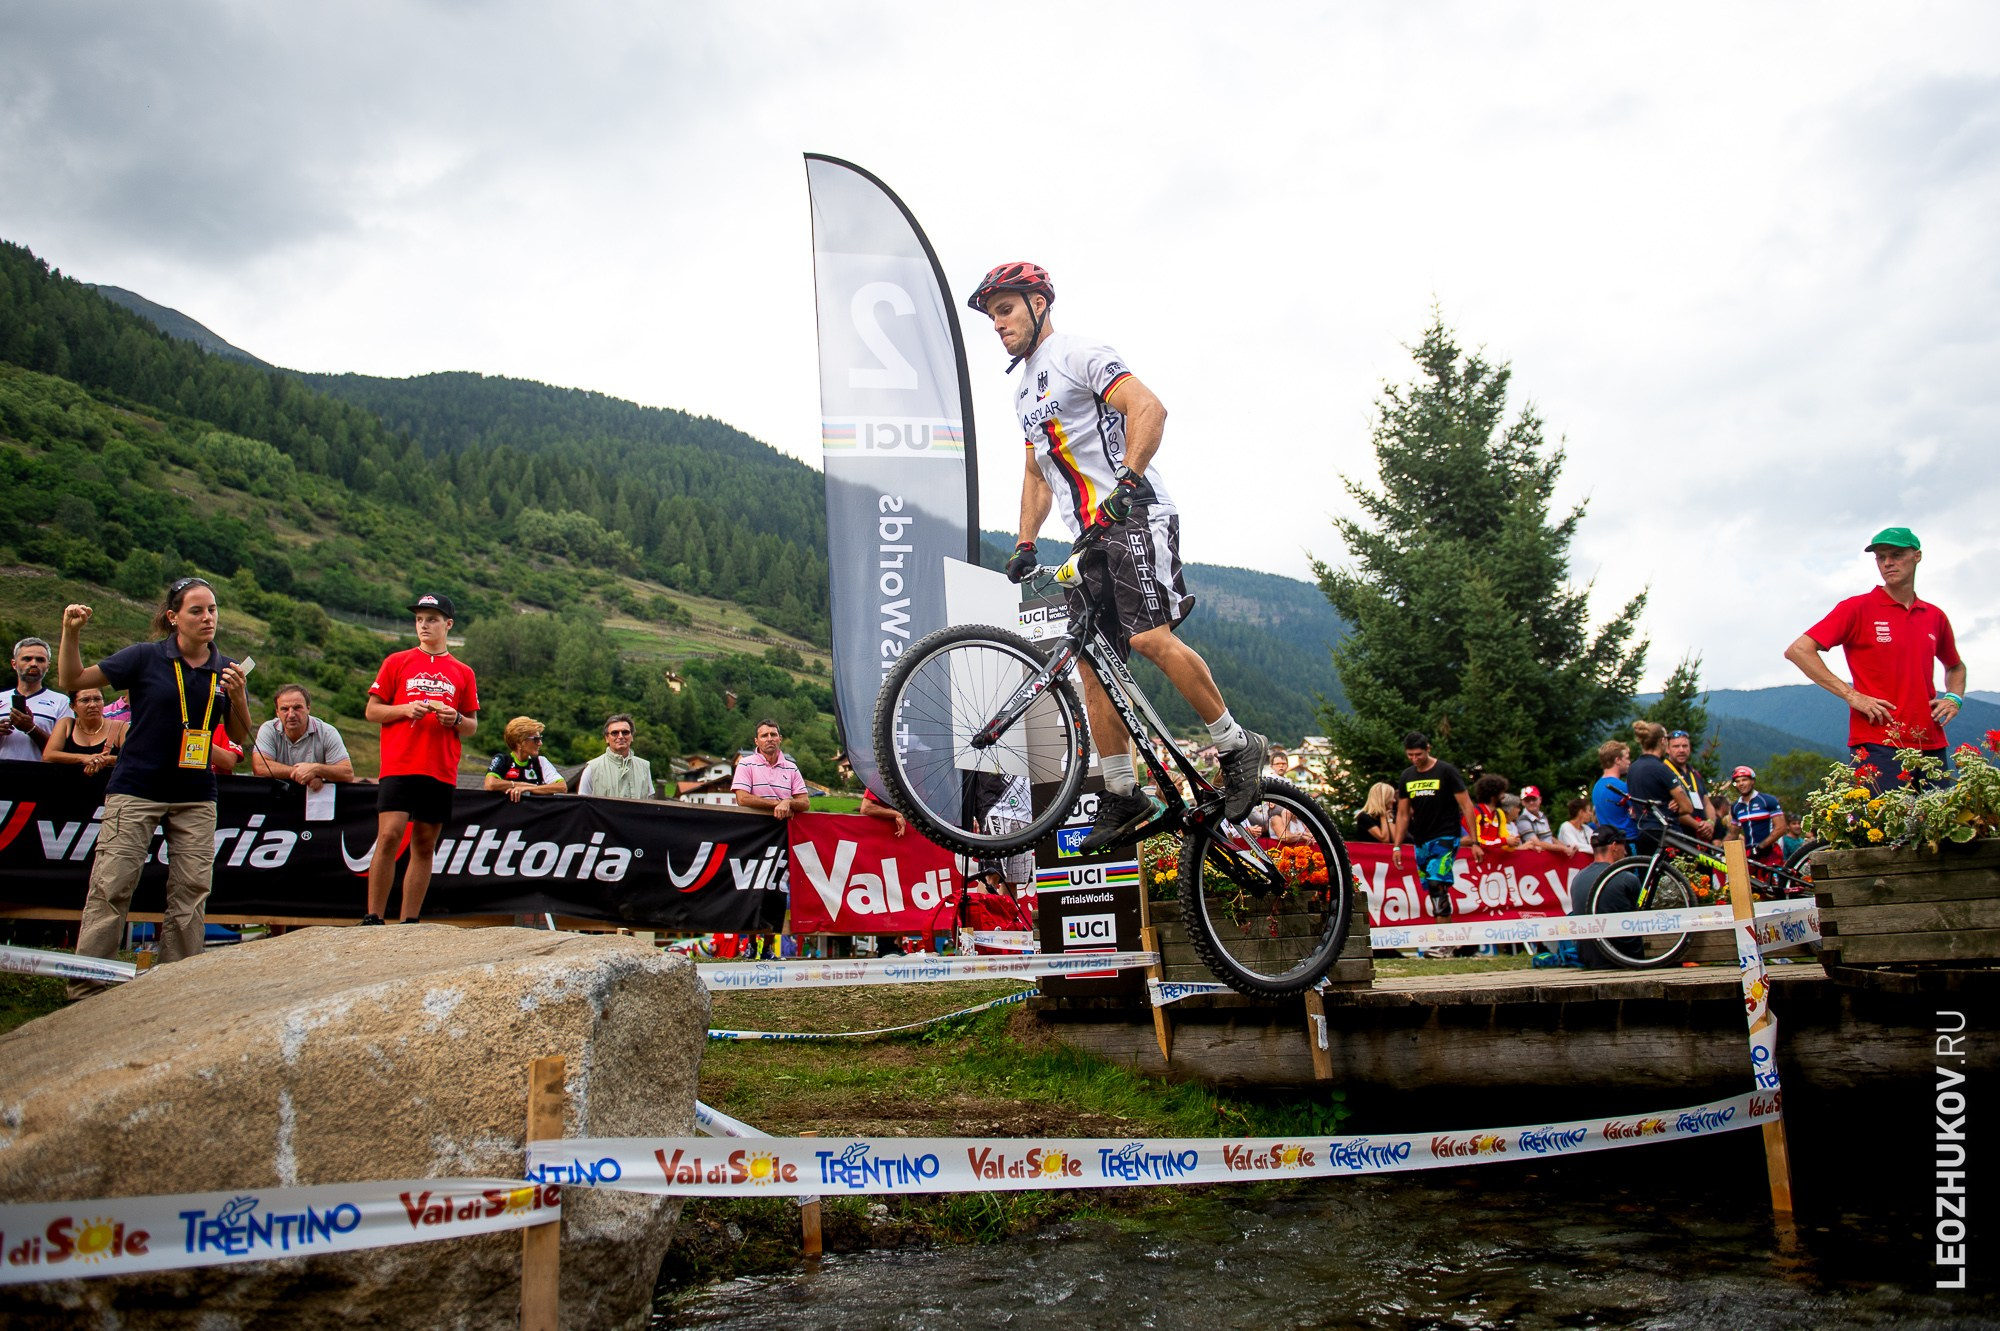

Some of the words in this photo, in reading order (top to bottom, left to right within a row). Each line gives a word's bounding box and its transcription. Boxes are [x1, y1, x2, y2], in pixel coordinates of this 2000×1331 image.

[1129, 533, 1160, 611] BIEHLER
[1023, 610, 1045, 625] UCI
[406, 677, 457, 698] BIKELAND
[1099, 641, 1135, 684] JEALOUSY
[37, 806, 298, 868] viria
[792, 839, 905, 923] Val
[911, 867, 953, 910] di
[1061, 892, 1114, 905] #TrialsWorlds
[1070, 868, 1102, 886] UCI
[1352, 862, 1420, 926] Val
[1076, 920, 1109, 938] UCI
[525, 1157, 622, 1187] NTINO
[654, 1149, 701, 1187] Val
[707, 1164, 727, 1184] di
[728, 1150, 798, 1186] Sole
[815, 1150, 940, 1189] TRENTINO
[967, 1147, 1005, 1181] Val
[1008, 1160, 1025, 1179] di
[1026, 1147, 1082, 1180] Sole
[1098, 1147, 1199, 1181] TRENTINO
[1223, 1144, 1252, 1173] Val
[1253, 1153, 1268, 1170] di
[1329, 1141, 1412, 1170] TRENTINO
[1430, 1136, 1456, 1160] Val
[1518, 1127, 1588, 1154] TRENTINO
[1676, 1106, 1736, 1133] TRENTINO
[8, 1236, 41, 1267] di
[179, 1203, 362, 1257] TRENTINO
[399, 1190, 454, 1230] Val
[457, 1199, 482, 1221] di
